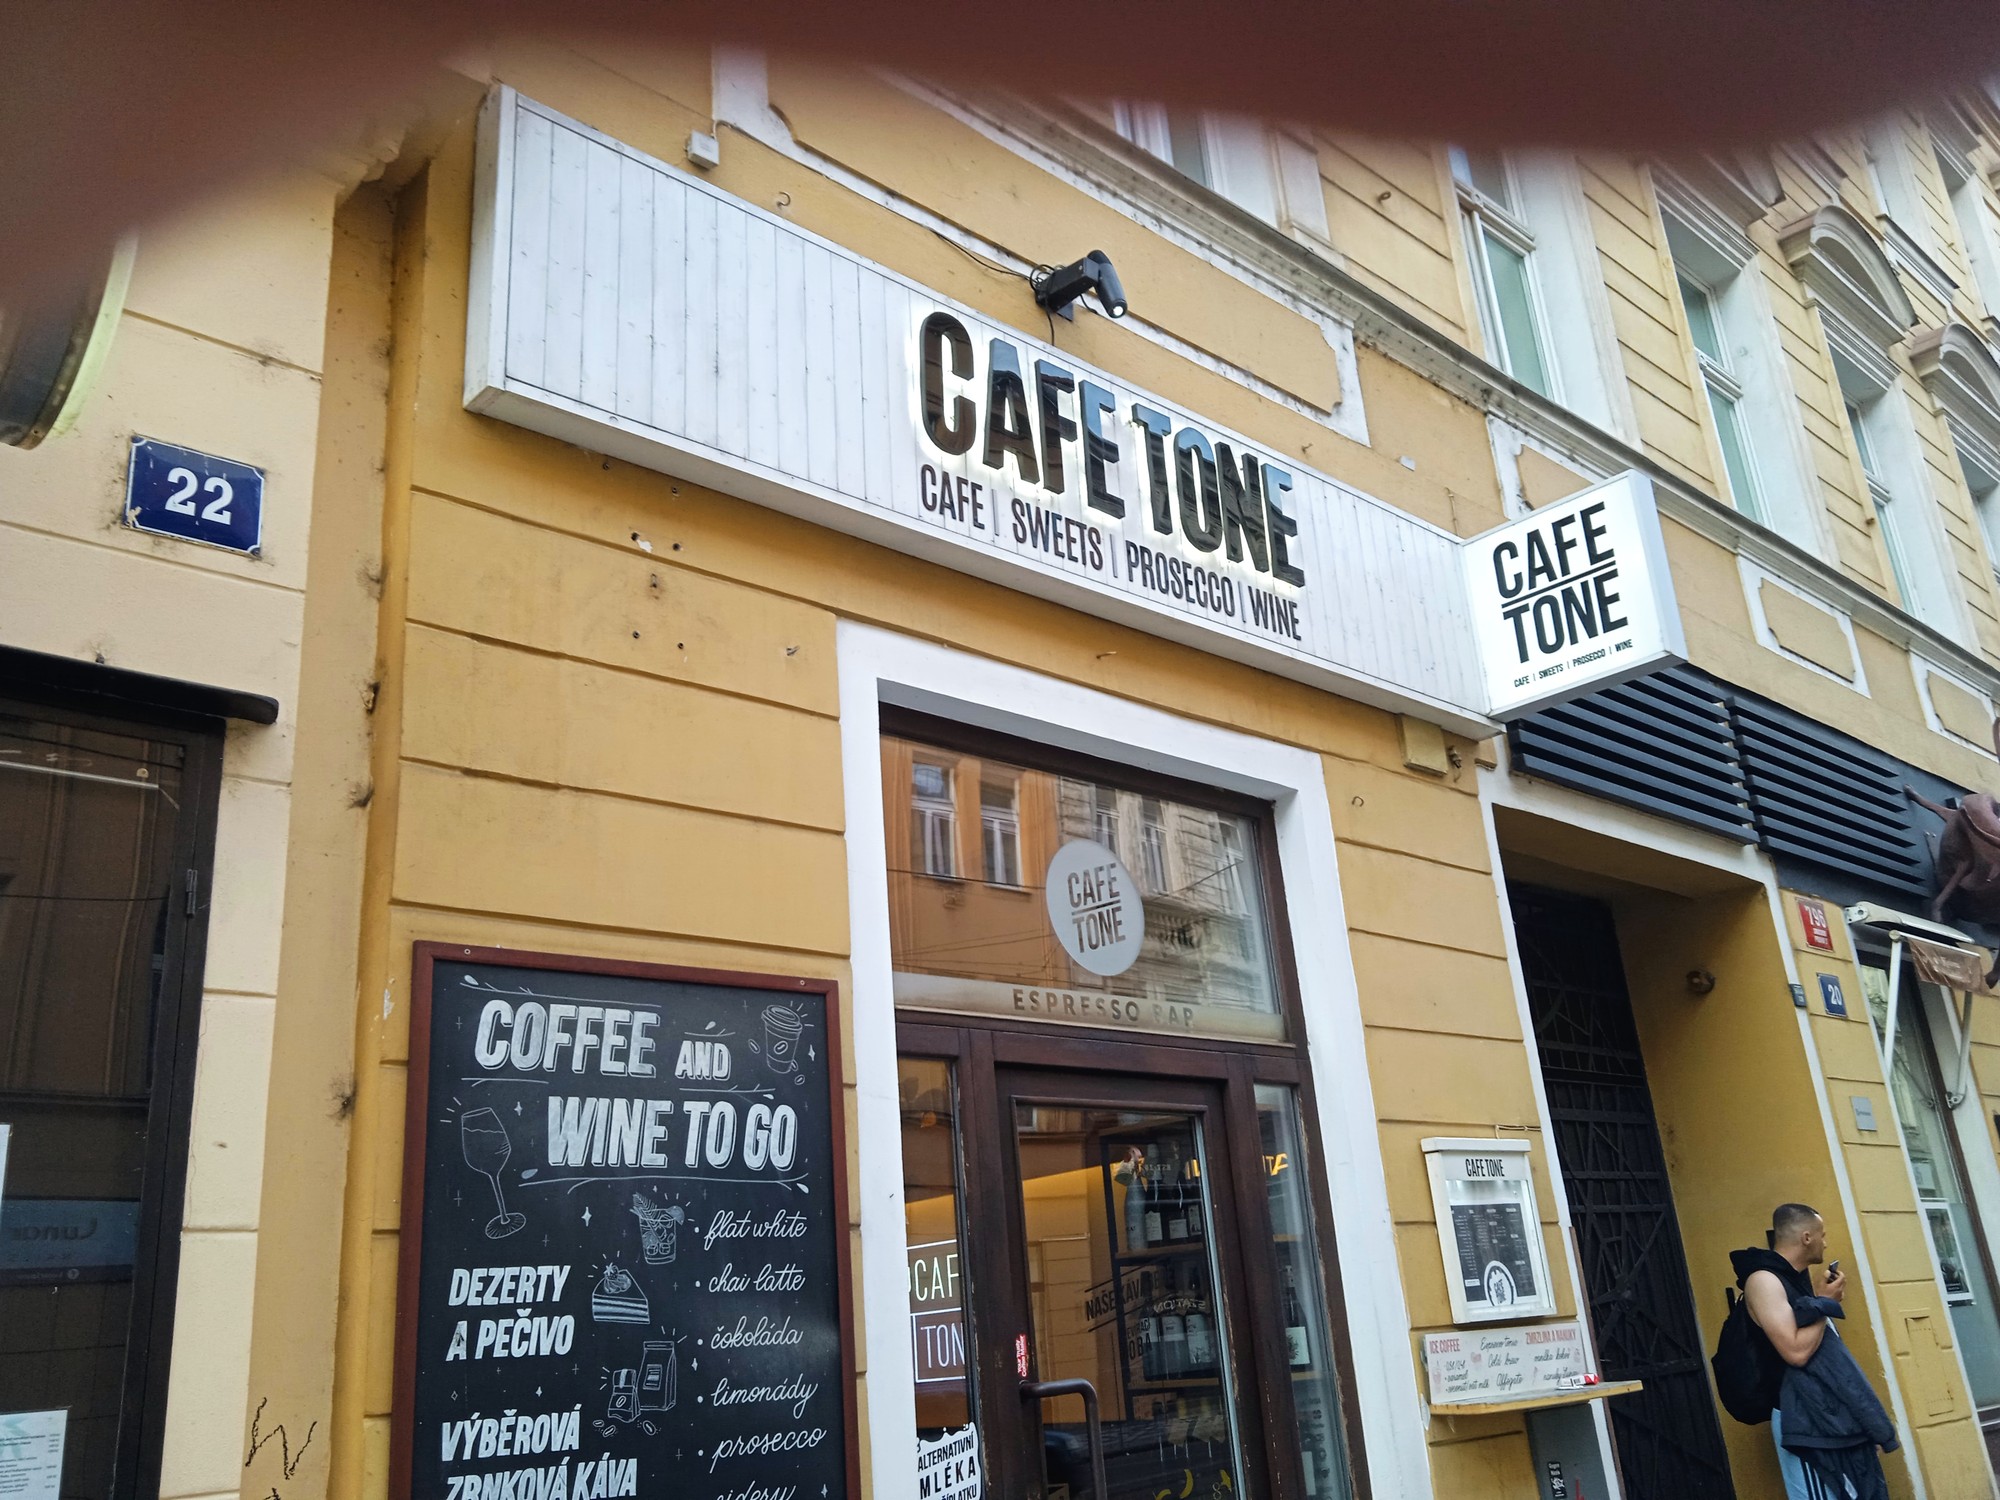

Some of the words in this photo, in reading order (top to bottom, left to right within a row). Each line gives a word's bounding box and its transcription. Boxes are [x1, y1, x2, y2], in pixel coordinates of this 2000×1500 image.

[920, 311, 1125, 520] CAFE
[1131, 403, 1305, 588] TONE
[165, 467, 234, 525] 22
[921, 464, 985, 530] CAFE
[1011, 498, 1104, 571] SWEETS
[1126, 540, 1236, 618] PROSECCO
[1248, 585, 1302, 642] WINE
[1493, 501, 1615, 599] CAFE
[1503, 568, 1629, 664] TONE
[1514, 675, 1530, 688] CAFE
[1538, 663, 1564, 679] SWEETS
[1572, 649, 1606, 667] PROSECCO
[1615, 639, 1633, 652] WINE
[1067, 862, 1120, 909] CAFE
[1072, 905, 1126, 953] TONE
[1012, 988, 1140, 1022] ESPRESSO
[1828, 984, 1842, 1006] 20
[474, 999, 661, 1079] COFFEE
[674, 1039, 732, 1080] AND
[547, 1095, 674, 1169] WINE
[683, 1100, 738, 1170] TO
[742, 1103, 798, 1172] GO
[1465, 1158, 1485, 1177] CAFE
[1485, 1158, 1505, 1177] TONE
[704, 1209, 749, 1251] flat
[751, 1210, 808, 1239] white
[447, 1265, 571, 1306] DEZERTY
[708, 1263, 750, 1293] chai
[754, 1263, 806, 1292] latte
[1085, 1290, 1117, 1322] NAŠE
[446, 1320, 468, 1361] A
[475, 1308, 576, 1359] PEČIVO
[710, 1316, 803, 1350] čokoláda
[710, 1373, 820, 1420] limonády
[441, 1403, 582, 1462] VÝBĚROVÁ
[709, 1428, 827, 1474] prosecco
[918, 1431, 974, 1472] ALTERNATIVNÍ
[573, 1452, 638, 1500] KÁVA
[920, 1455, 976, 1500] MLÉKA
